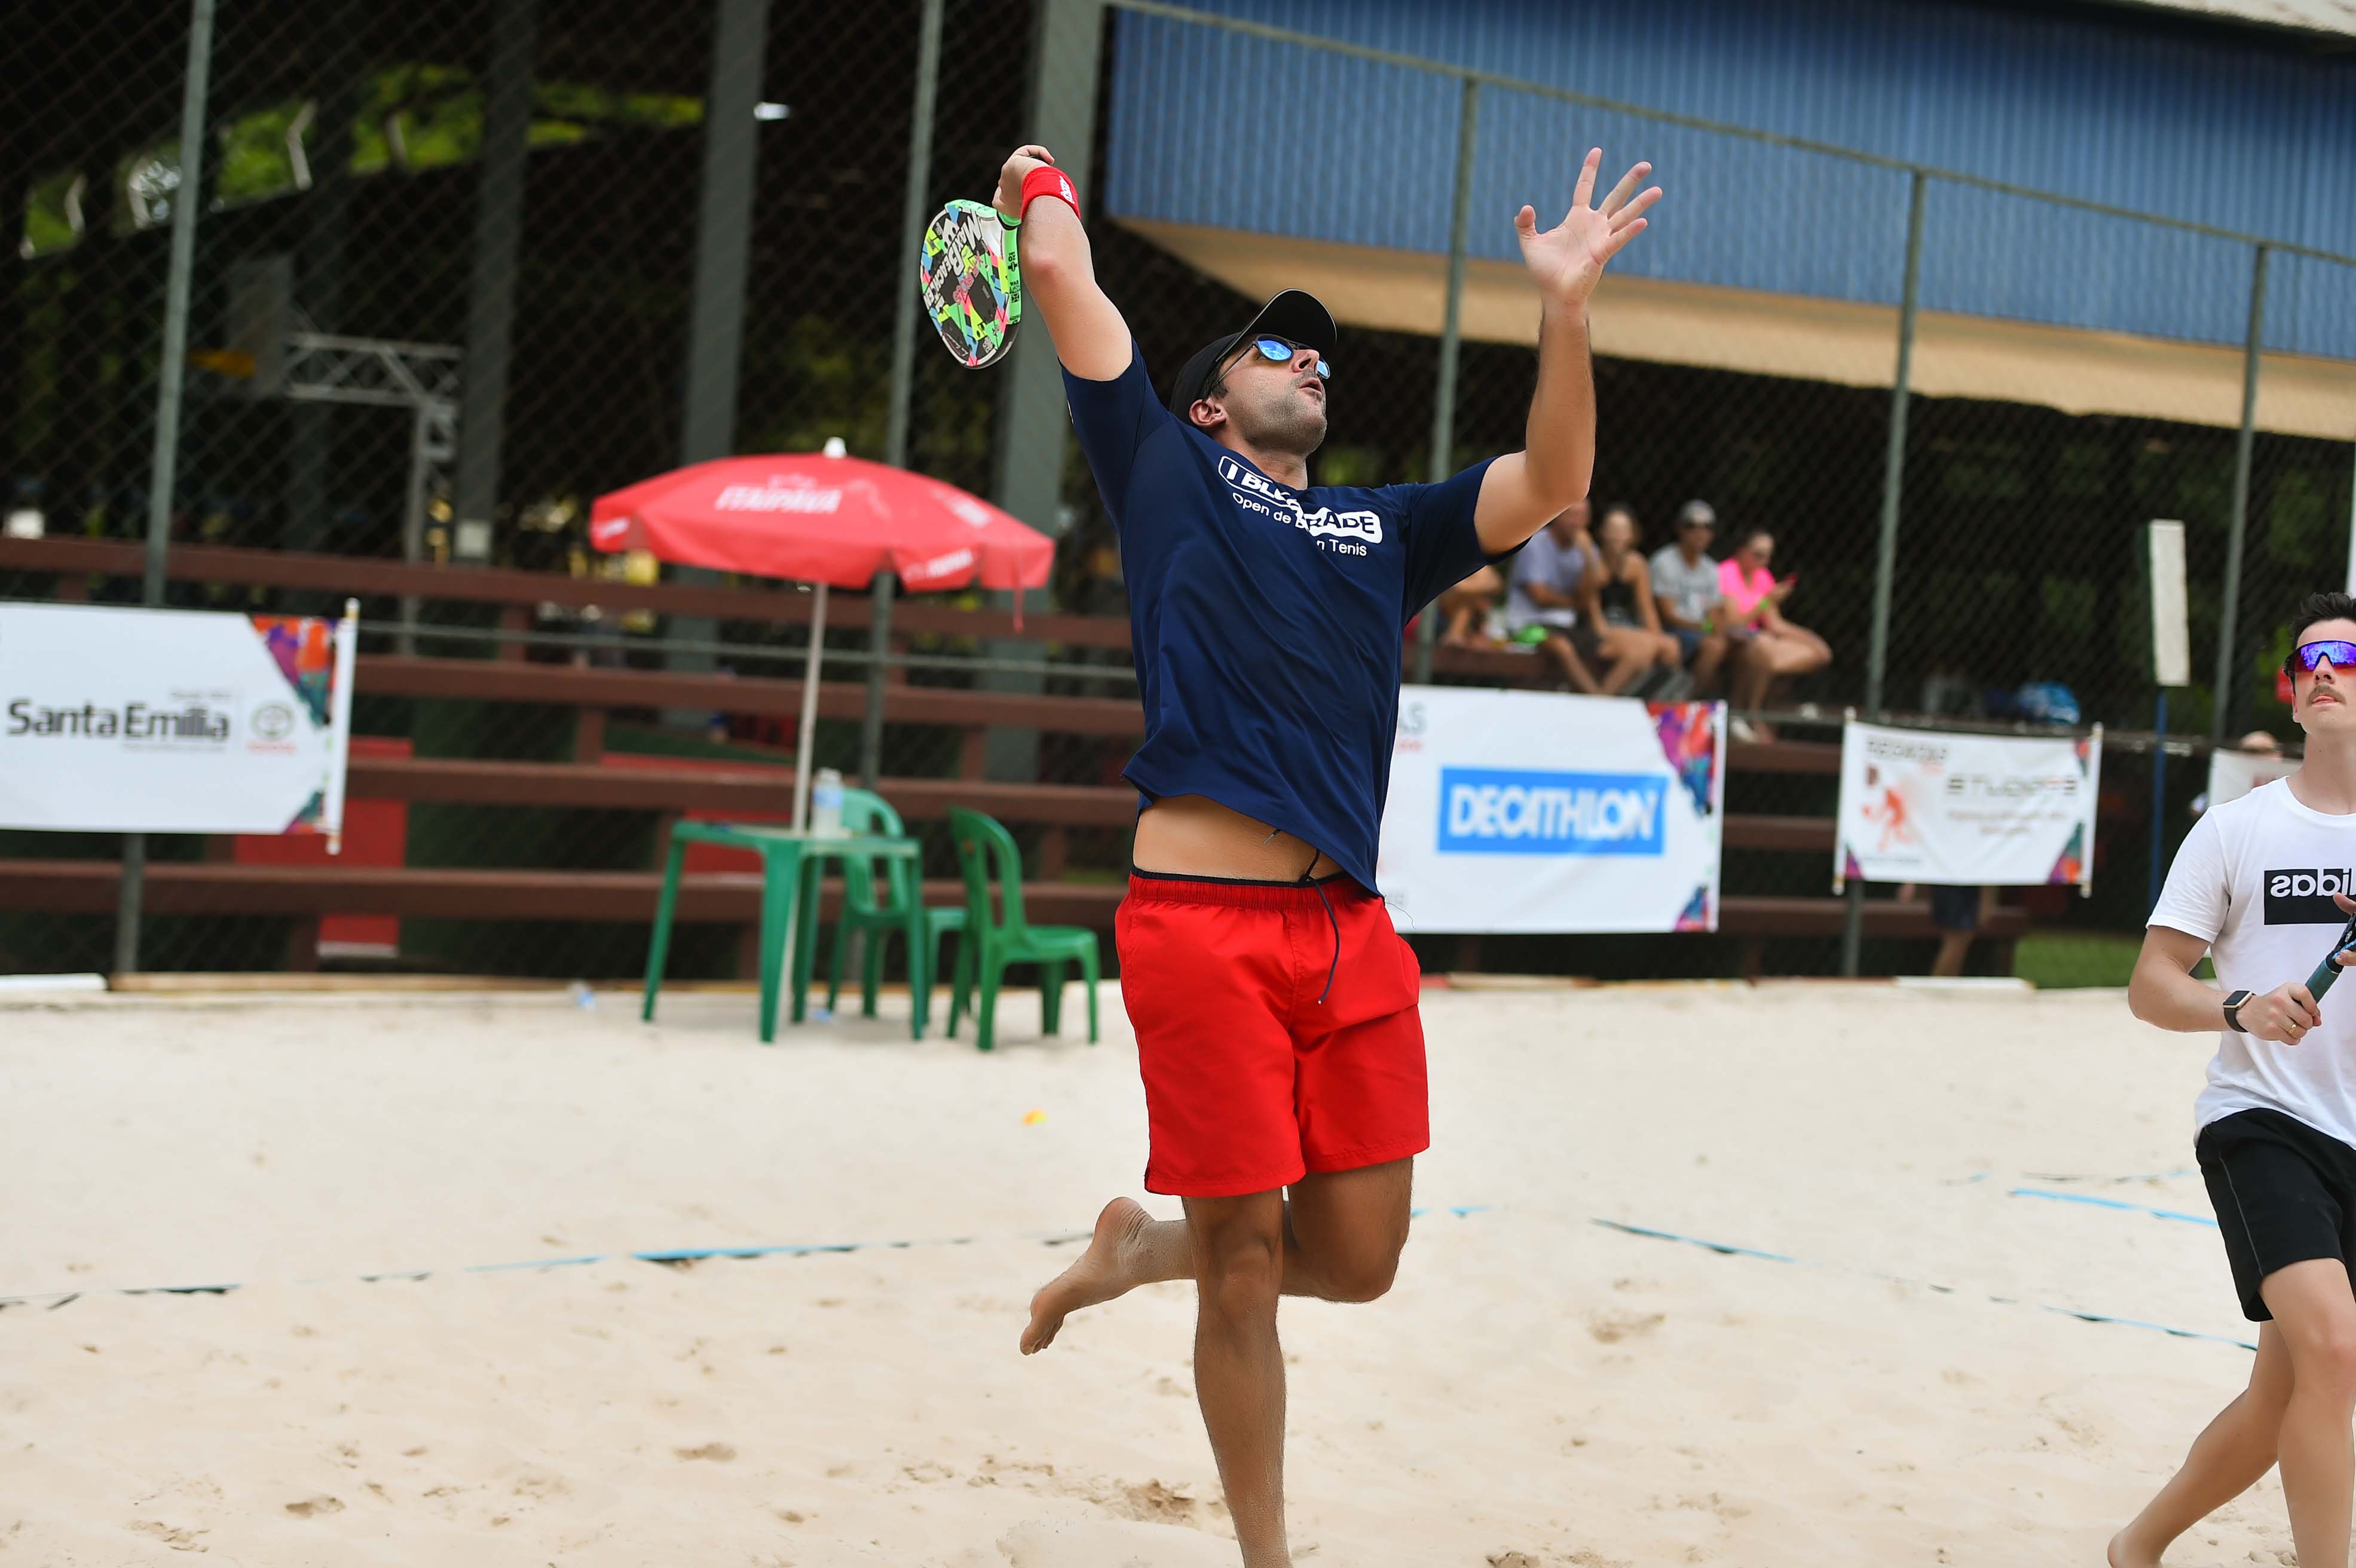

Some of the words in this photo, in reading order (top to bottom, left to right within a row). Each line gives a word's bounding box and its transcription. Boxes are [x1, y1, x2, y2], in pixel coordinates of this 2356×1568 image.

[1226, 464, 1238, 480] I
[1233, 492, 1269, 516] Open
[1274, 512, 1291, 523] de
[1329, 539, 1367, 556] Tenis
[1449, 783, 1657, 839] DECATHLON
